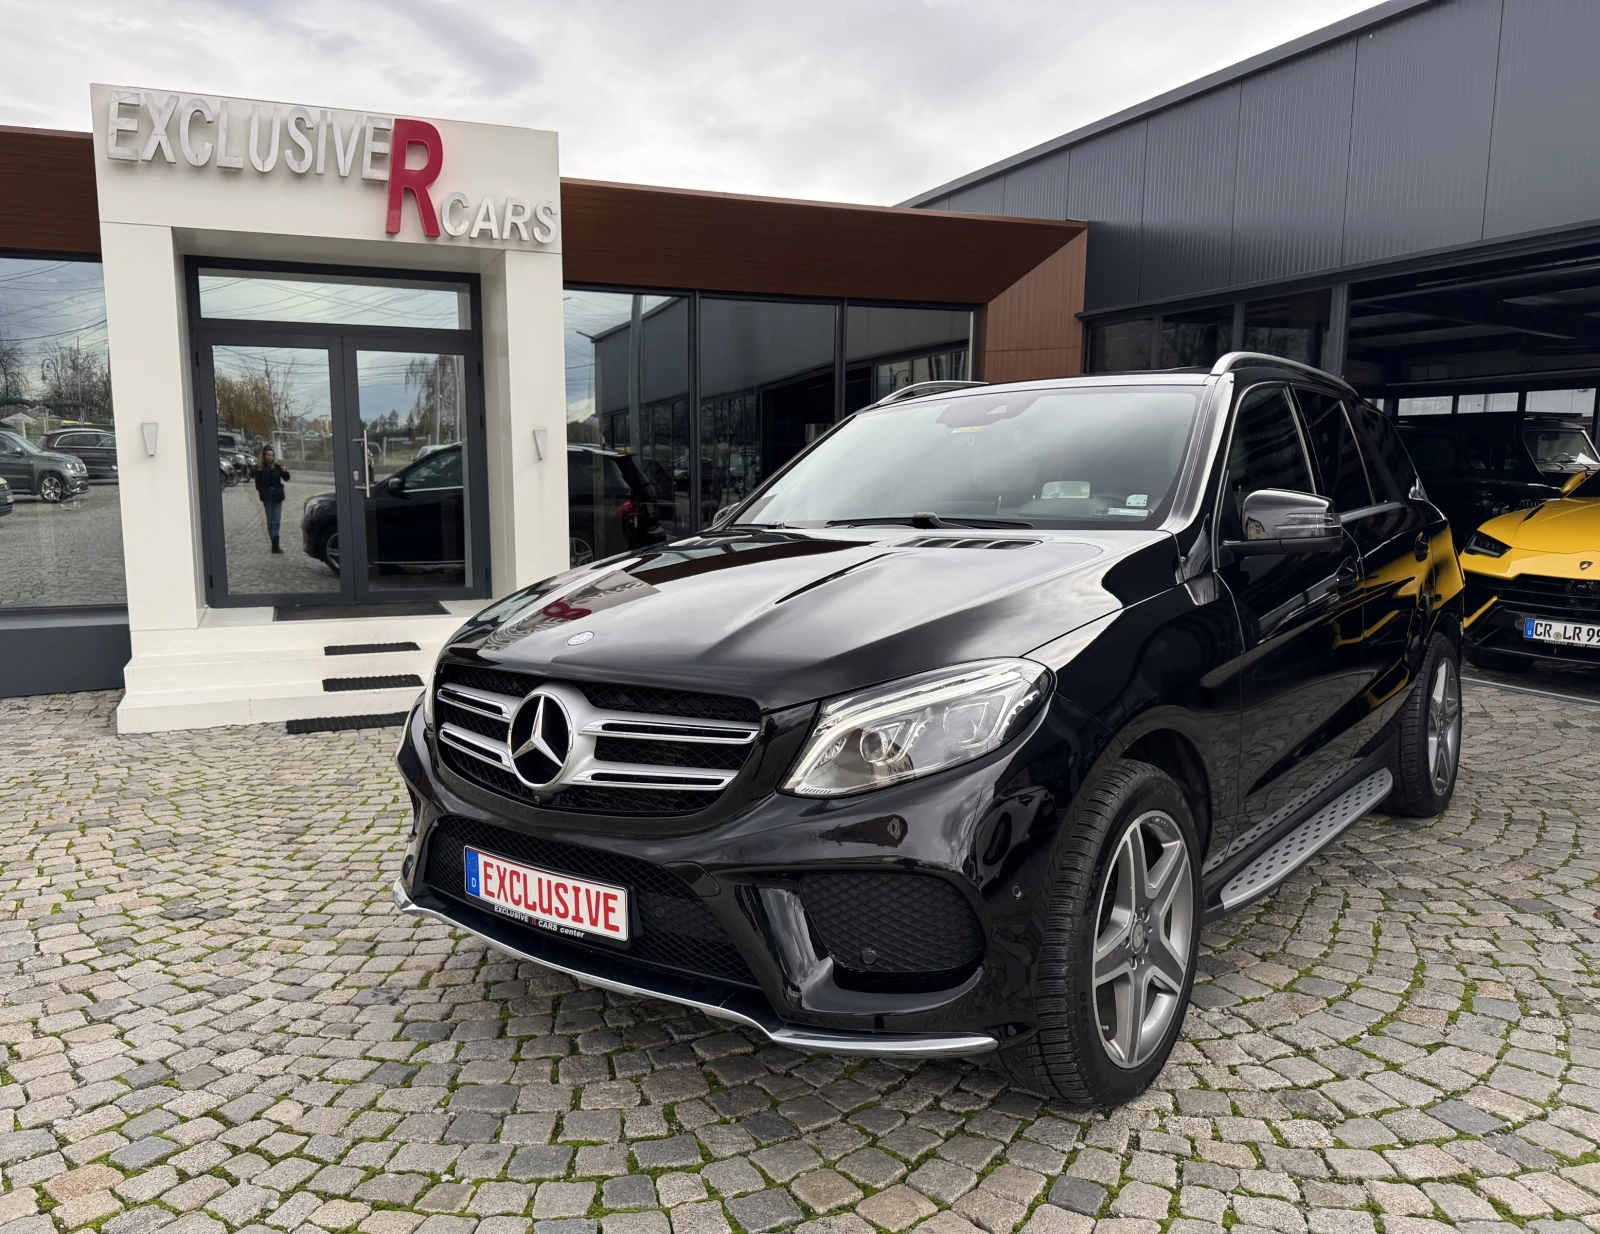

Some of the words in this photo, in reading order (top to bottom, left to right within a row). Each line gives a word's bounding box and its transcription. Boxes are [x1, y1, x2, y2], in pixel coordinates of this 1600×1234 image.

[107, 90, 393, 182] EXCLUSIVE
[385, 118, 443, 237] R
[441, 191, 558, 244] CARS
[1534, 622, 1552, 638] CR
[1563, 625, 1582, 641] LR
[471, 877, 477, 888] D
[483, 860, 620, 932] EXCLUSIVE
[494, 904, 529, 923] EXCLUSIVE
[538, 920, 558, 932] CARS
[560, 926, 585, 938] center
